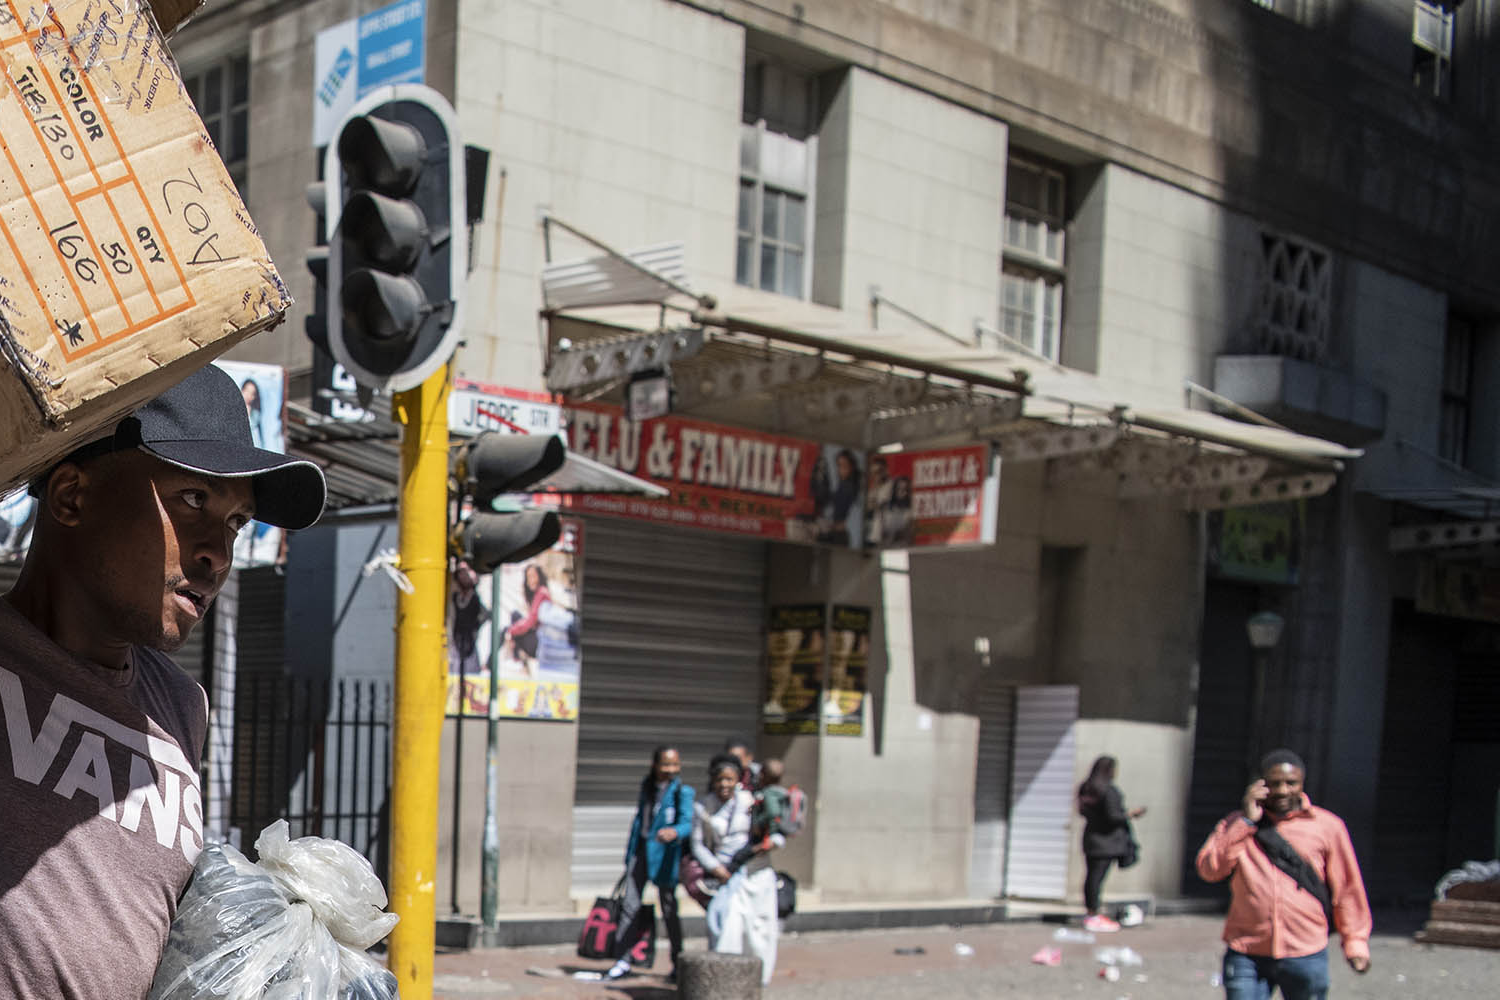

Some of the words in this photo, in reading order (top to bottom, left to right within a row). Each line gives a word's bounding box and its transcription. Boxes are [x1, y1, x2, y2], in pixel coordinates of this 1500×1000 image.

[60, 67, 104, 142] COLOR
[143, 69, 162, 108] JOEDIR
[101, 242, 133, 275] 50
[136, 226, 165, 264] QTY
[565, 407, 642, 472] ELU
[645, 424, 675, 477] &
[679, 428, 800, 497] FAMILY
